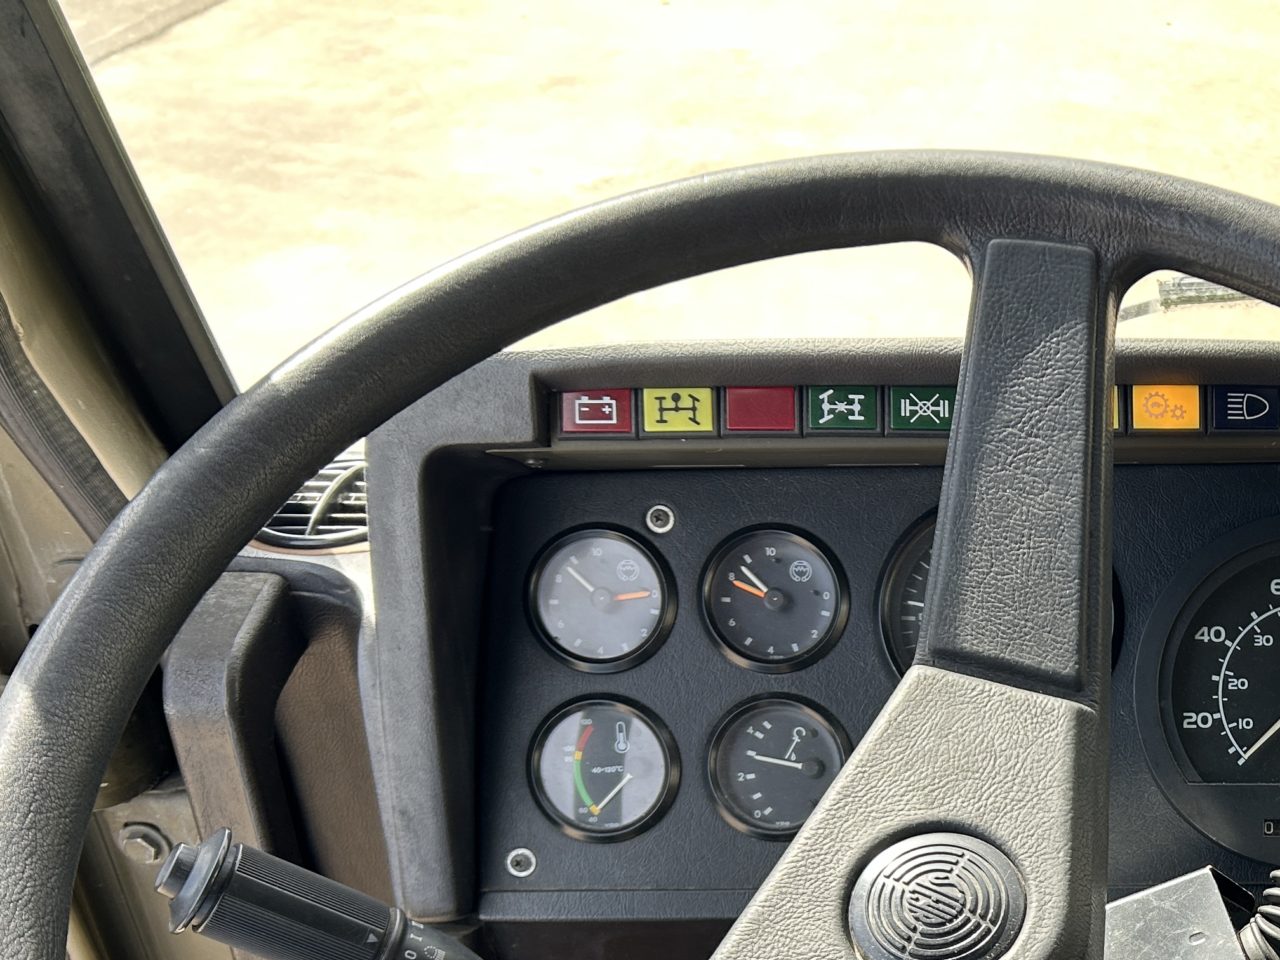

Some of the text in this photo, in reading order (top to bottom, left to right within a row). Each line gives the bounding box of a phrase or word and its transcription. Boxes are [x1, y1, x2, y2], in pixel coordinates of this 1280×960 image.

[765, 547, 776, 556] 10
[728, 572, 735, 580] 8
[822, 591, 830, 600] 0
[728, 618, 736, 626] 6
[811, 629, 819, 639] 2
[1195, 626, 1226, 643] 40
[1253, 635, 1274, 646] 30
[767, 645, 775, 654] 4
[1228, 678, 1249, 690] 20
[1183, 712, 1213, 729] 20
[1238, 718, 1254, 730] 10
[737, 772, 745, 781] 2
[753, 810, 761, 818] 0
